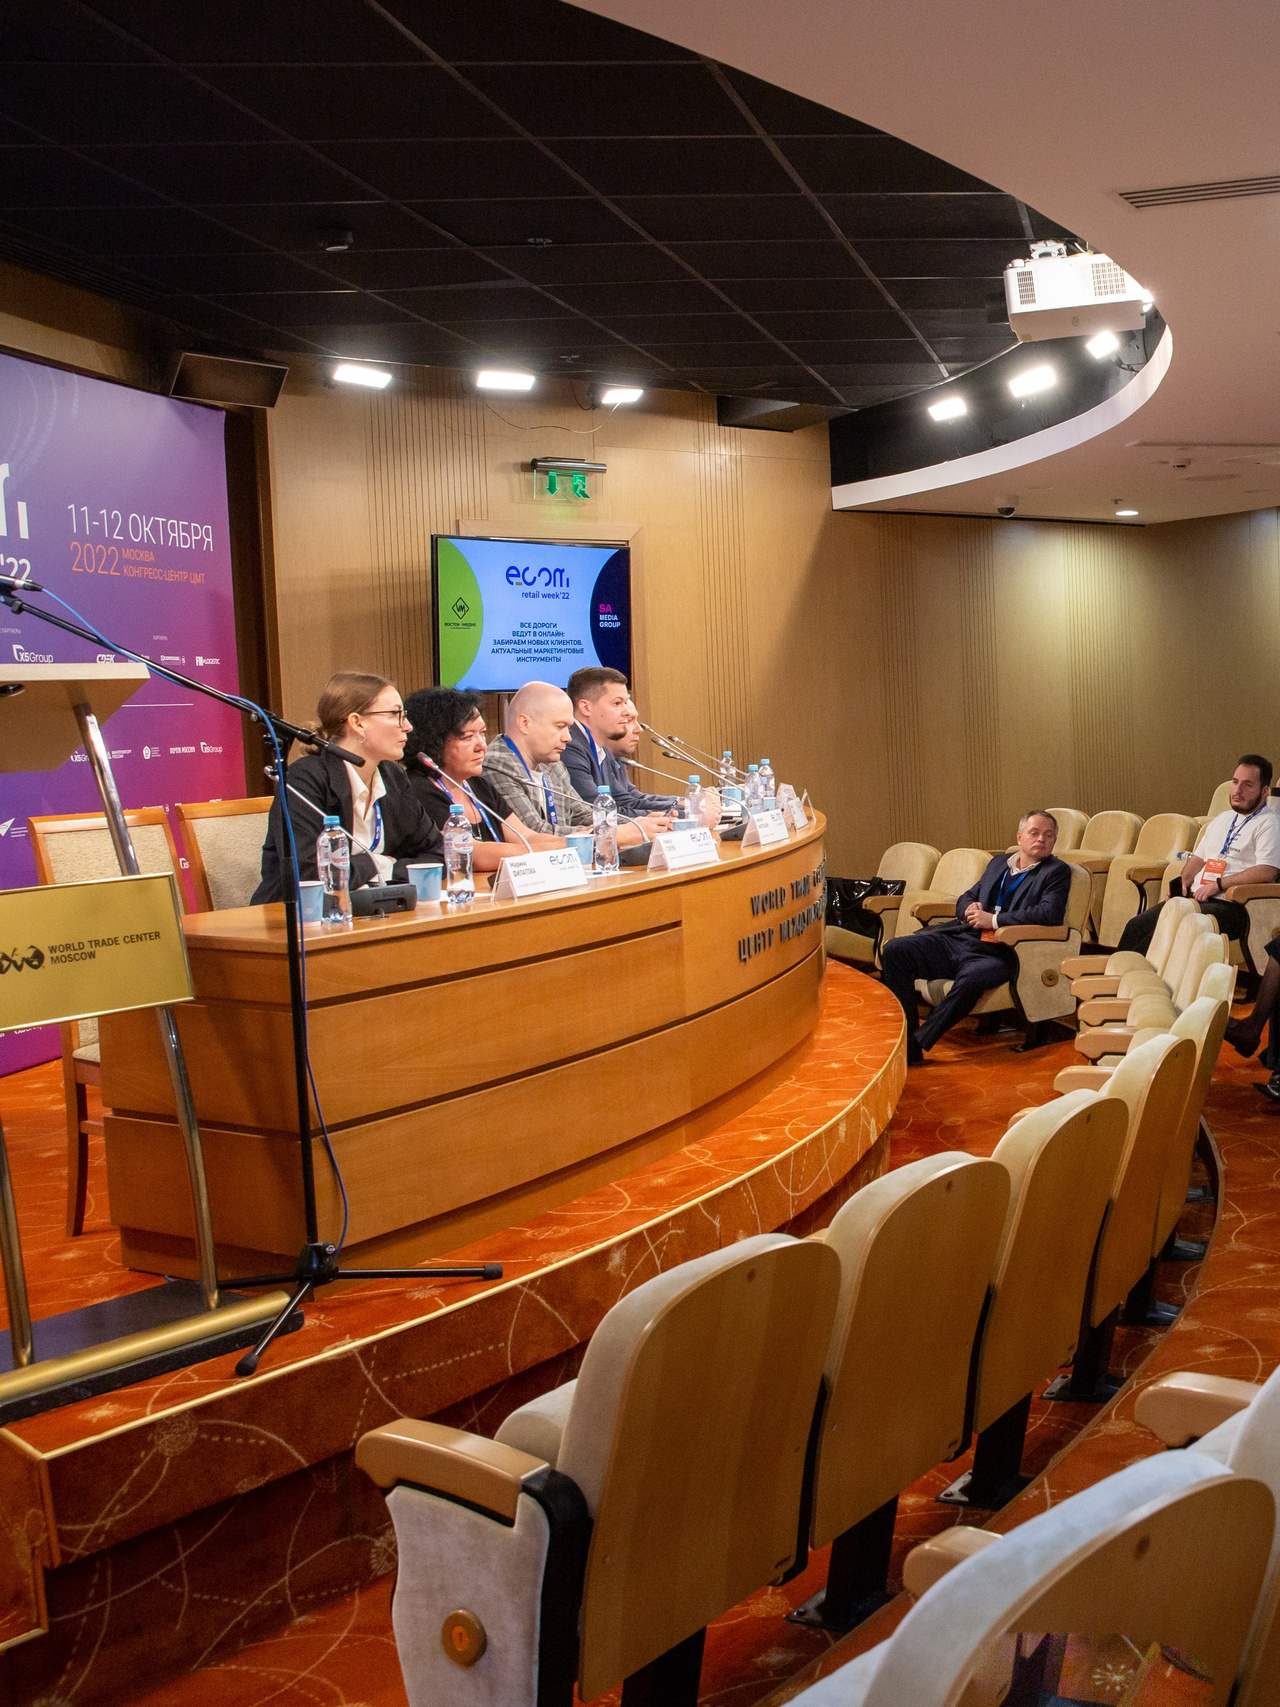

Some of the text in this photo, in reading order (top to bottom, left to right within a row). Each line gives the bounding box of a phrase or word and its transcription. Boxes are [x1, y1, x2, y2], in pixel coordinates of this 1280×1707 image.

[68, 503, 214, 551] 11-12 ОКТЯБРЯ
[70, 541, 121, 576] 2022
[122, 548, 155, 562] МОСКВА
[123, 566, 205, 584] КОНГРЕСС-ЦЕНТР ЦМТ
[521, 591, 570, 600] retail week'22
[599, 603, 612, 614] SA
[532, 622, 558, 630] ДОРОГИ
[512, 630, 530, 638] ВЕДУТ
[534, 647, 585, 655] МАРКЕТИНГОВЫЕ
[516, 655, 562, 663] ИНСТРУМЕНТЫ
[751, 886, 787, 917] WORLD
[48, 930, 161, 955] WORLD TRADE CENTER
[738, 927, 775, 963] ЦЕНТР
[50, 951, 96, 965] MOSCOW
